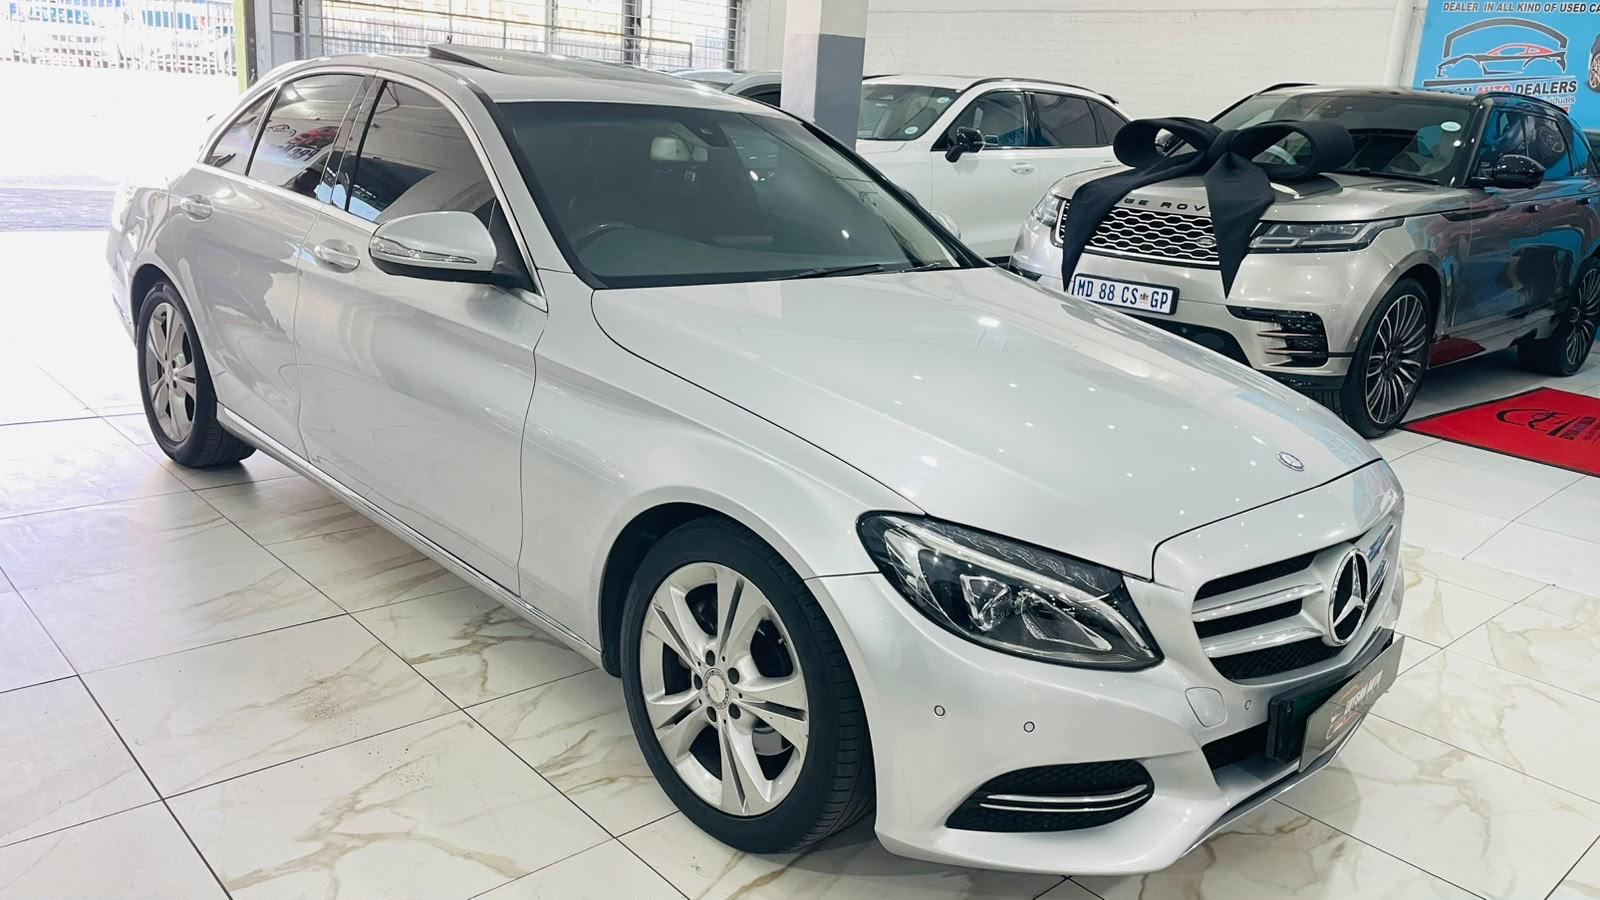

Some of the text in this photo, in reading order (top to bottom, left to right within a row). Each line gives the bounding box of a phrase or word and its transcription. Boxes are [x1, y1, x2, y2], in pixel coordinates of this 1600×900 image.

[1443, 2, 1478, 12] DEALER
[1484, 3, 1494, 12] IN
[1496, 3, 1514, 12] ALL
[1517, 3, 1540, 12] KIND
[1544, 3, 1557, 12] OF
[1560, 3, 1586, 12] USED
[1515, 80, 1577, 96] DEALERS
[1160, 201, 1207, 212] ROV
[1077, 279, 1169, 310] MD 88 CS GP
